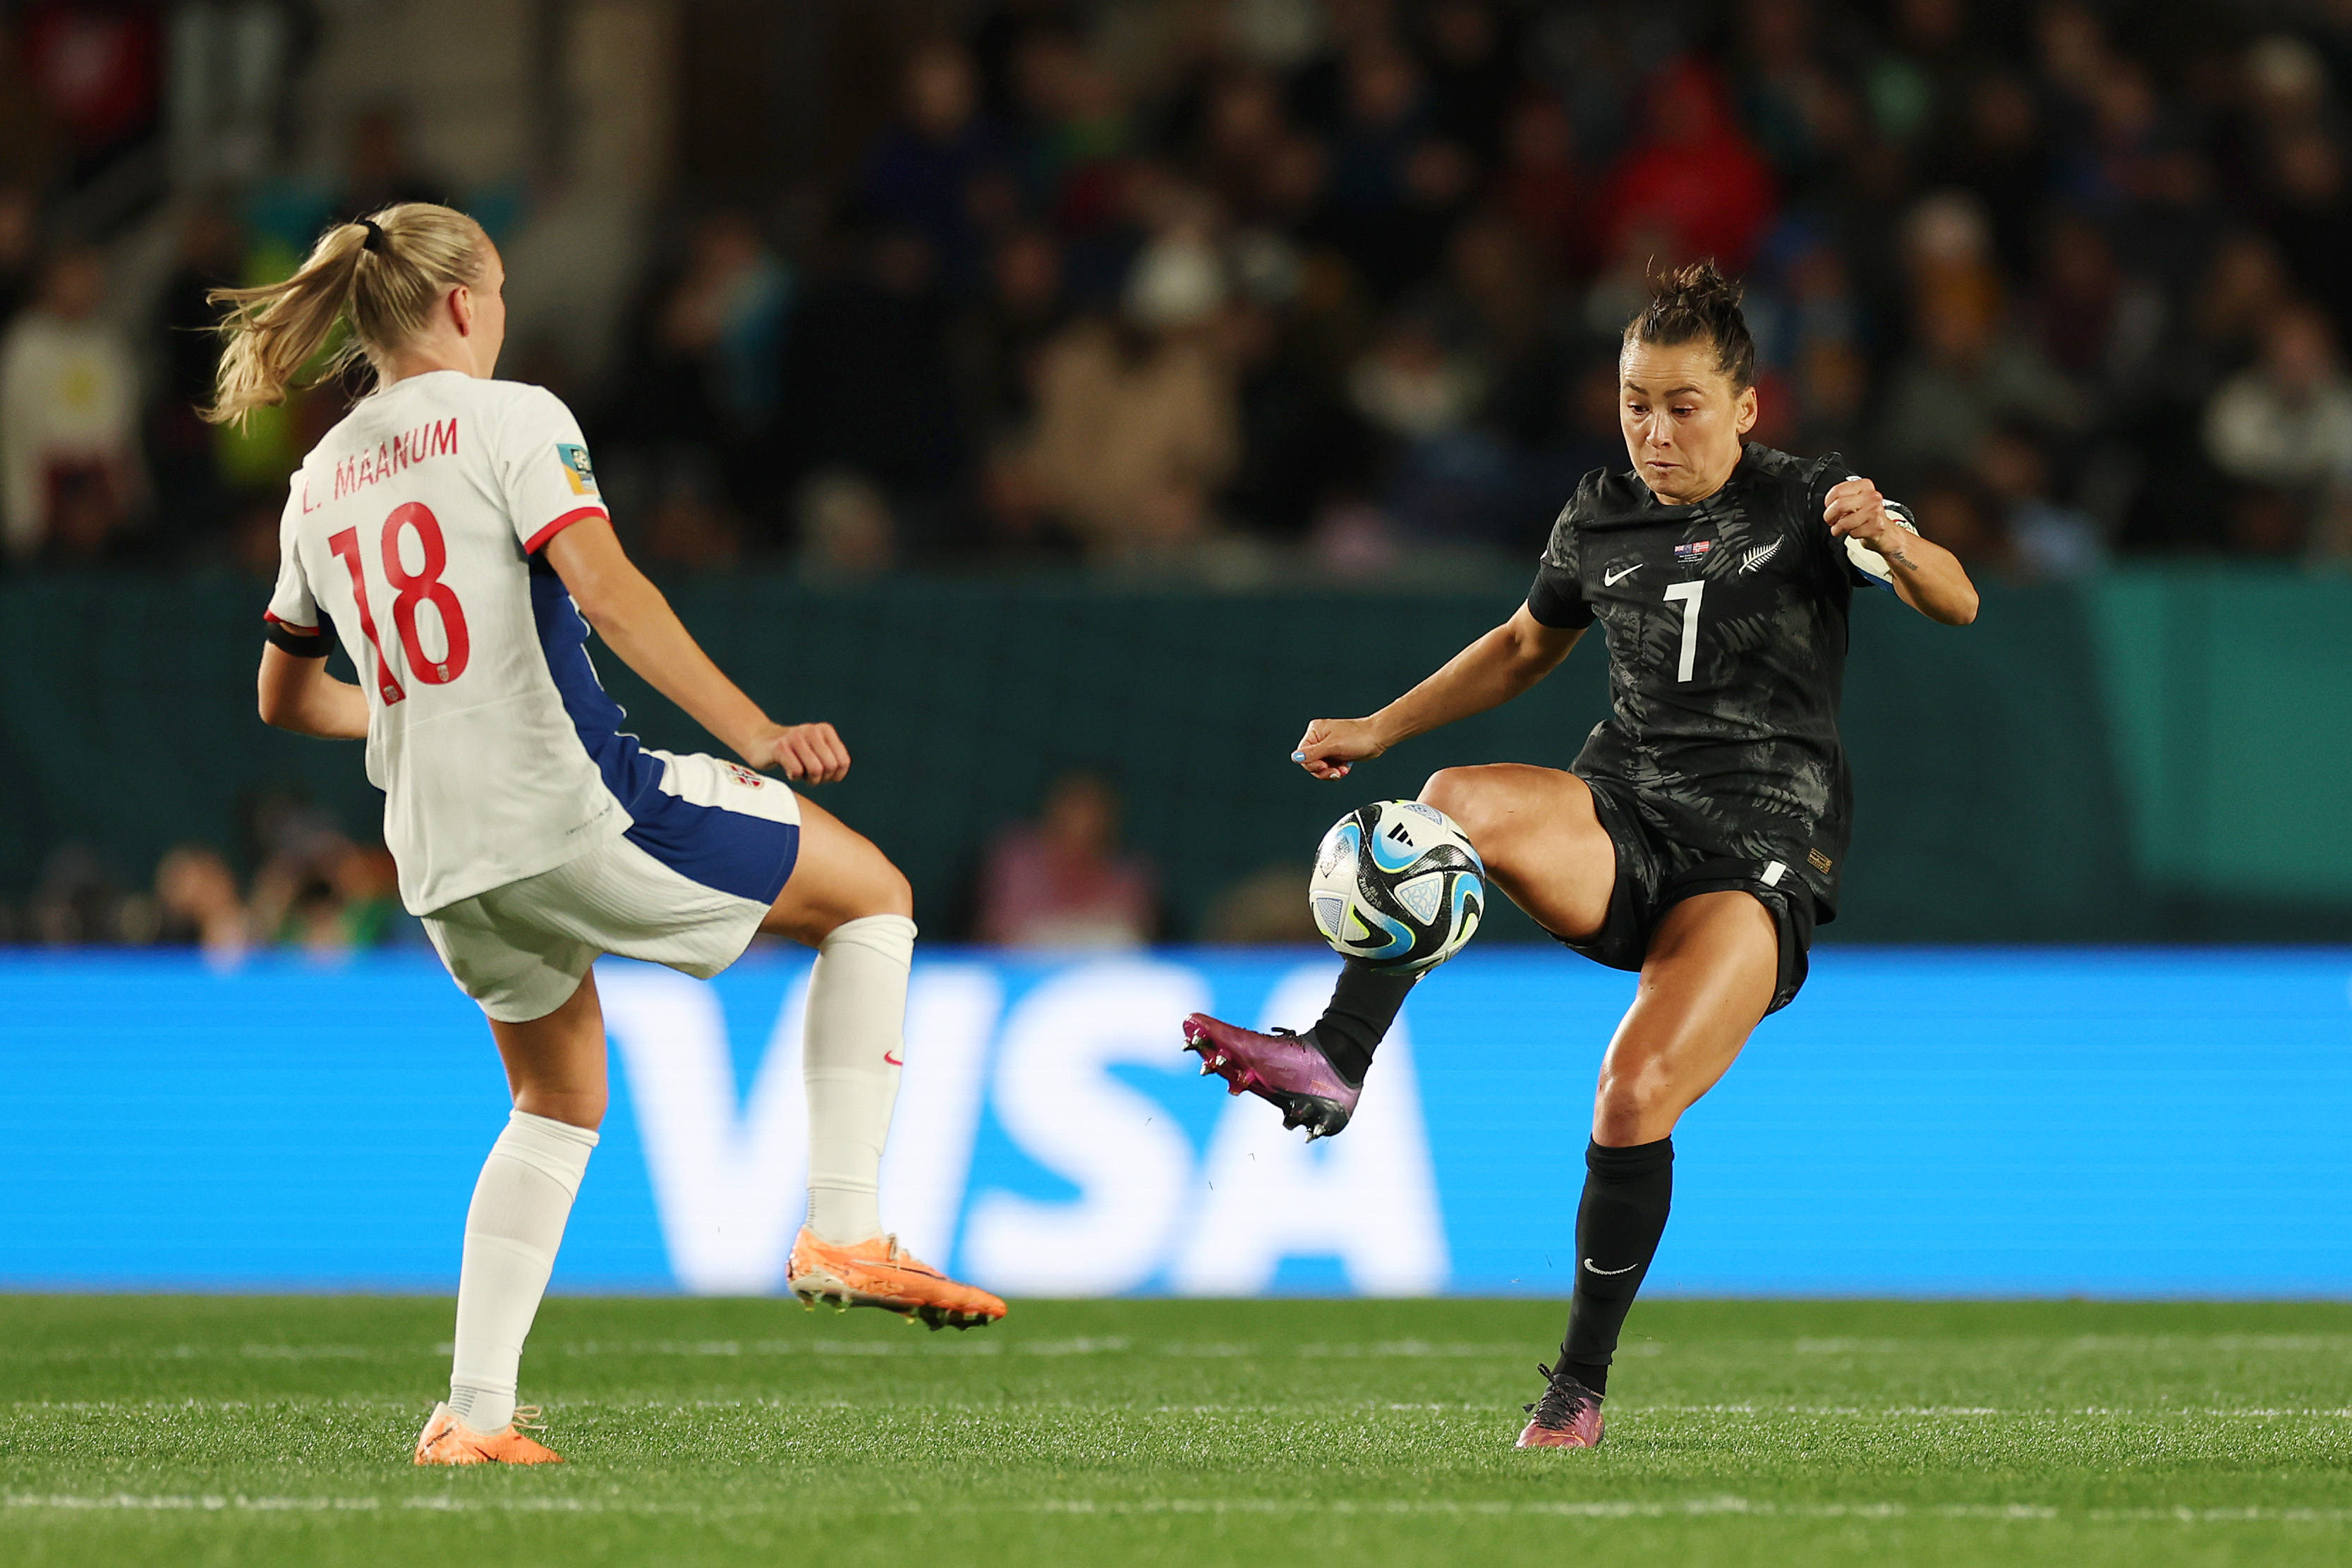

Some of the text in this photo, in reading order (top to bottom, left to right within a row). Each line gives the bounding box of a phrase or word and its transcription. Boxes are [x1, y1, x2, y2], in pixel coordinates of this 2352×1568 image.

[303, 418, 457, 515] L. MAANUM
[328, 501, 471, 707] 18
[1663, 580, 1705, 682] 7
[594, 964, 1449, 1295] VISA
